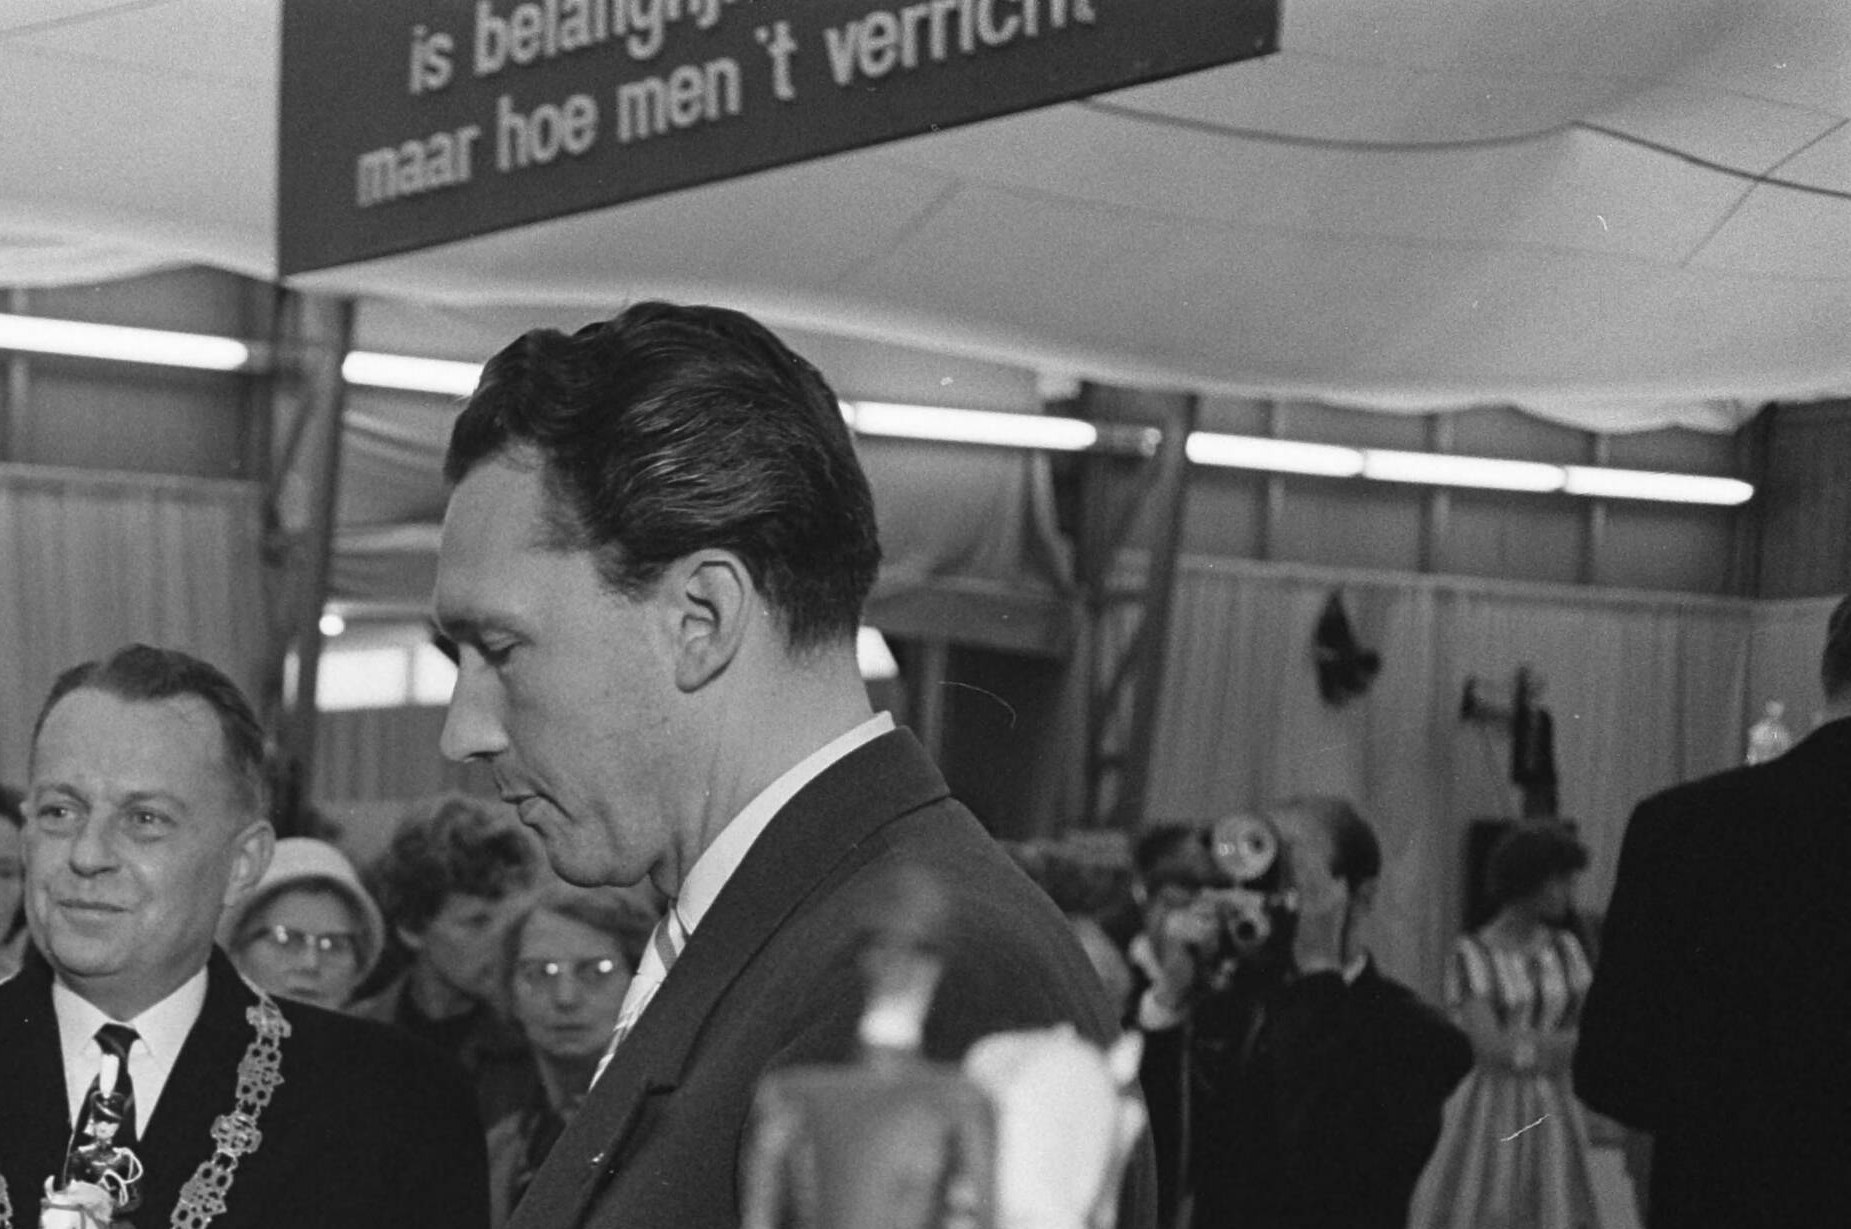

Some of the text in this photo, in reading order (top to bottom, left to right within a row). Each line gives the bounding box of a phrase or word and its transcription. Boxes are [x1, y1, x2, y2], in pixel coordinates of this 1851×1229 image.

[357, 0, 1096, 208] maar hoe men 't verric
[409, 23, 455, 95] is
